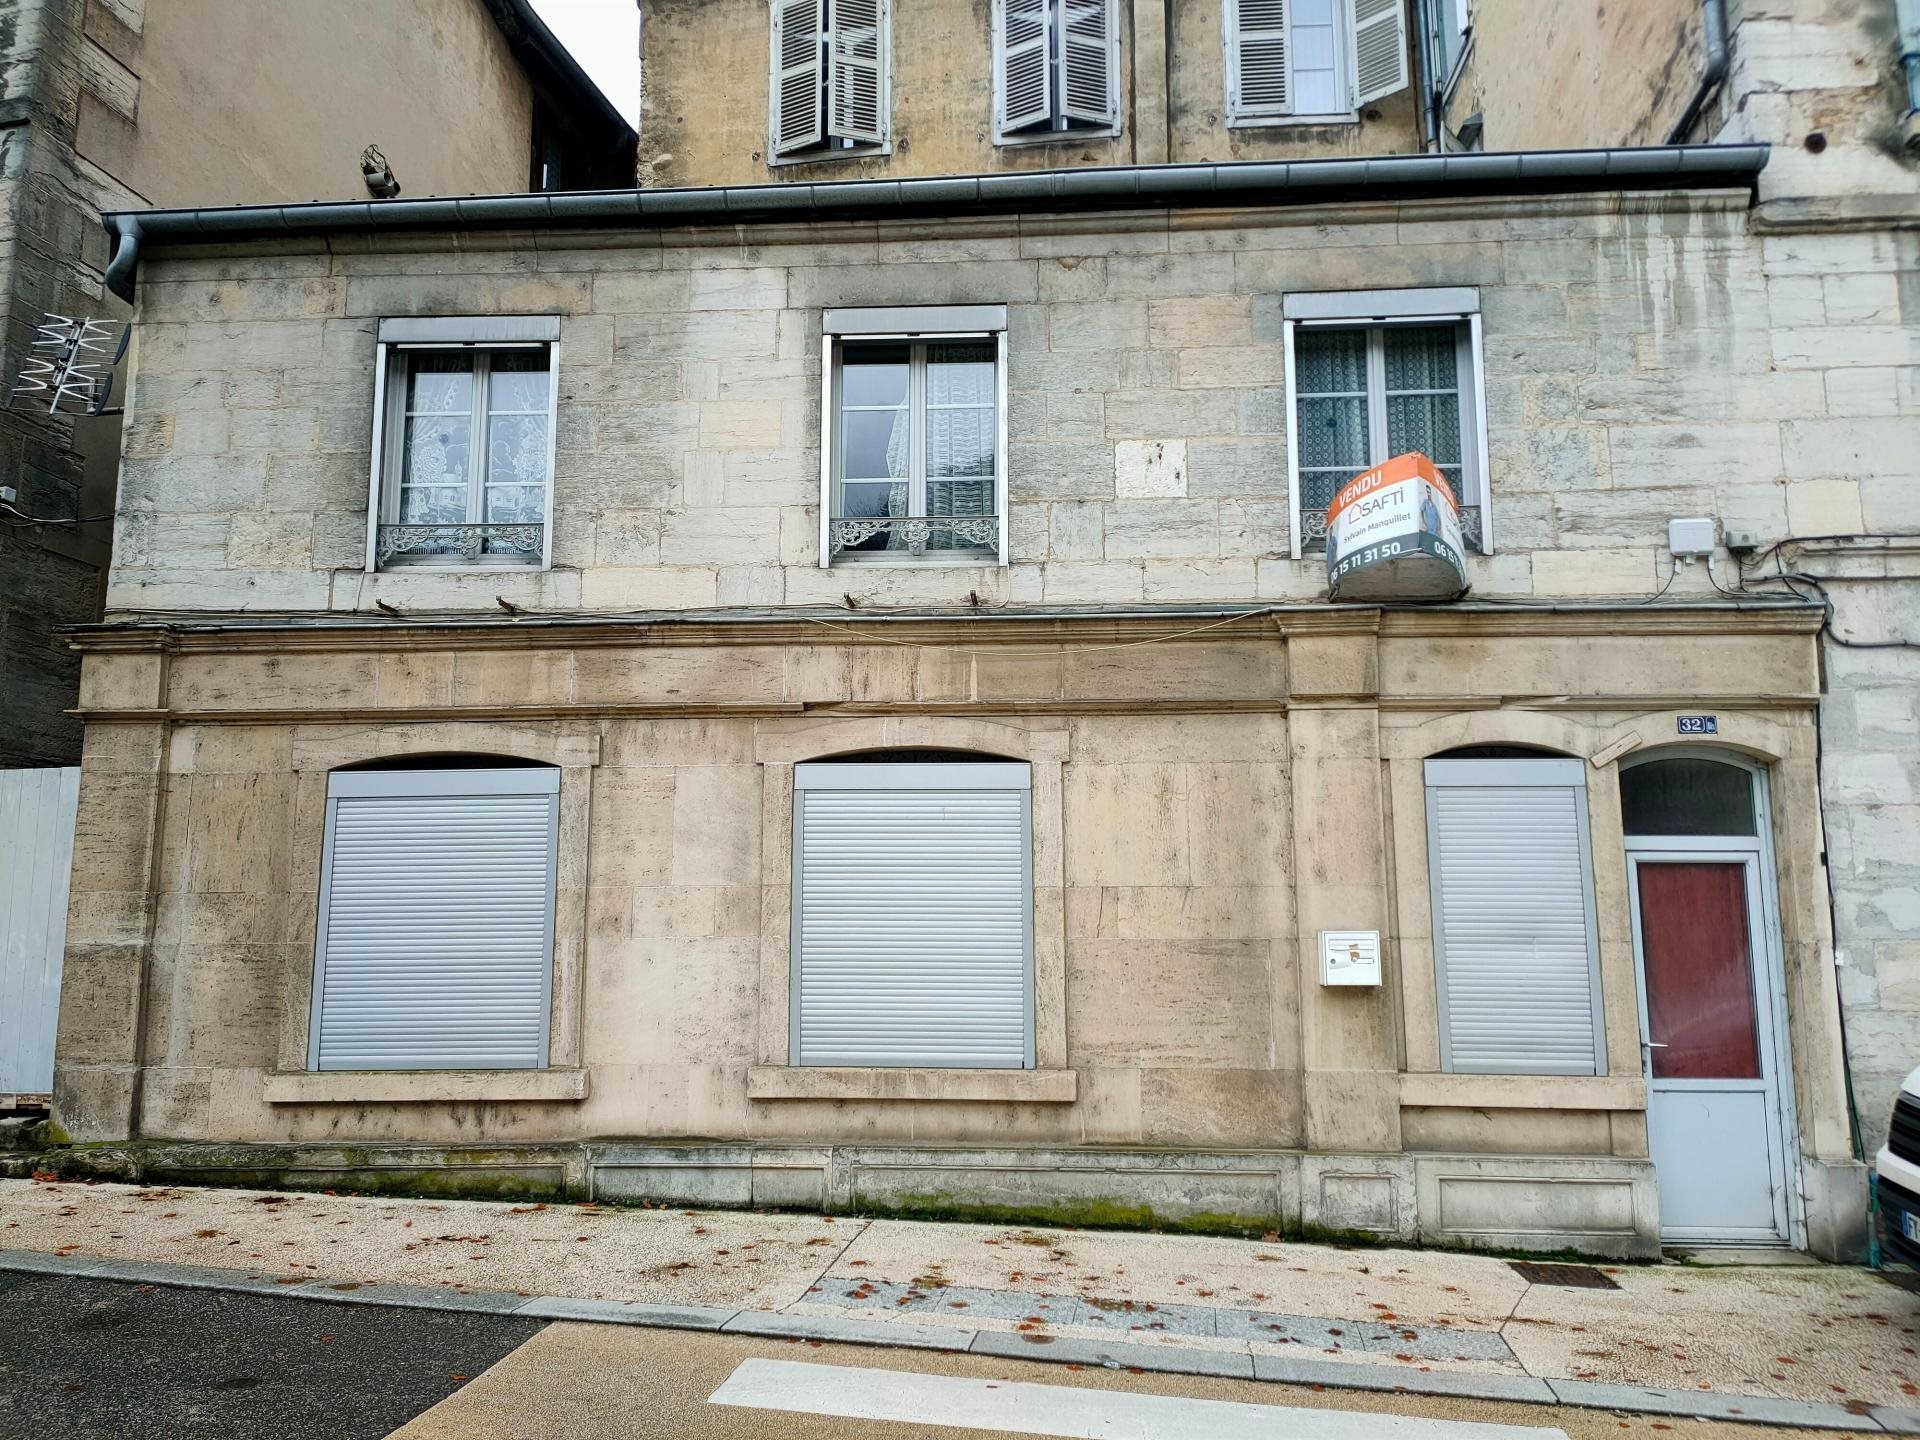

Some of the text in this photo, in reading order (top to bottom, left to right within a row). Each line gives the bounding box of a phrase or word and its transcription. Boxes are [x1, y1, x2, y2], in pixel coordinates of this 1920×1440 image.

[1340, 469, 1382, 508] VENDU
[1344, 512, 1412, 544] Sylvain Manquillet
[1339, 559, 1349, 575] 15
[1351, 553, 1361, 568] 11
[1364, 547, 1378, 563] 31
[1381, 541, 1401, 558] 50
[1434, 541, 1447, 557] 06
[1681, 718, 1702, 731] 32
